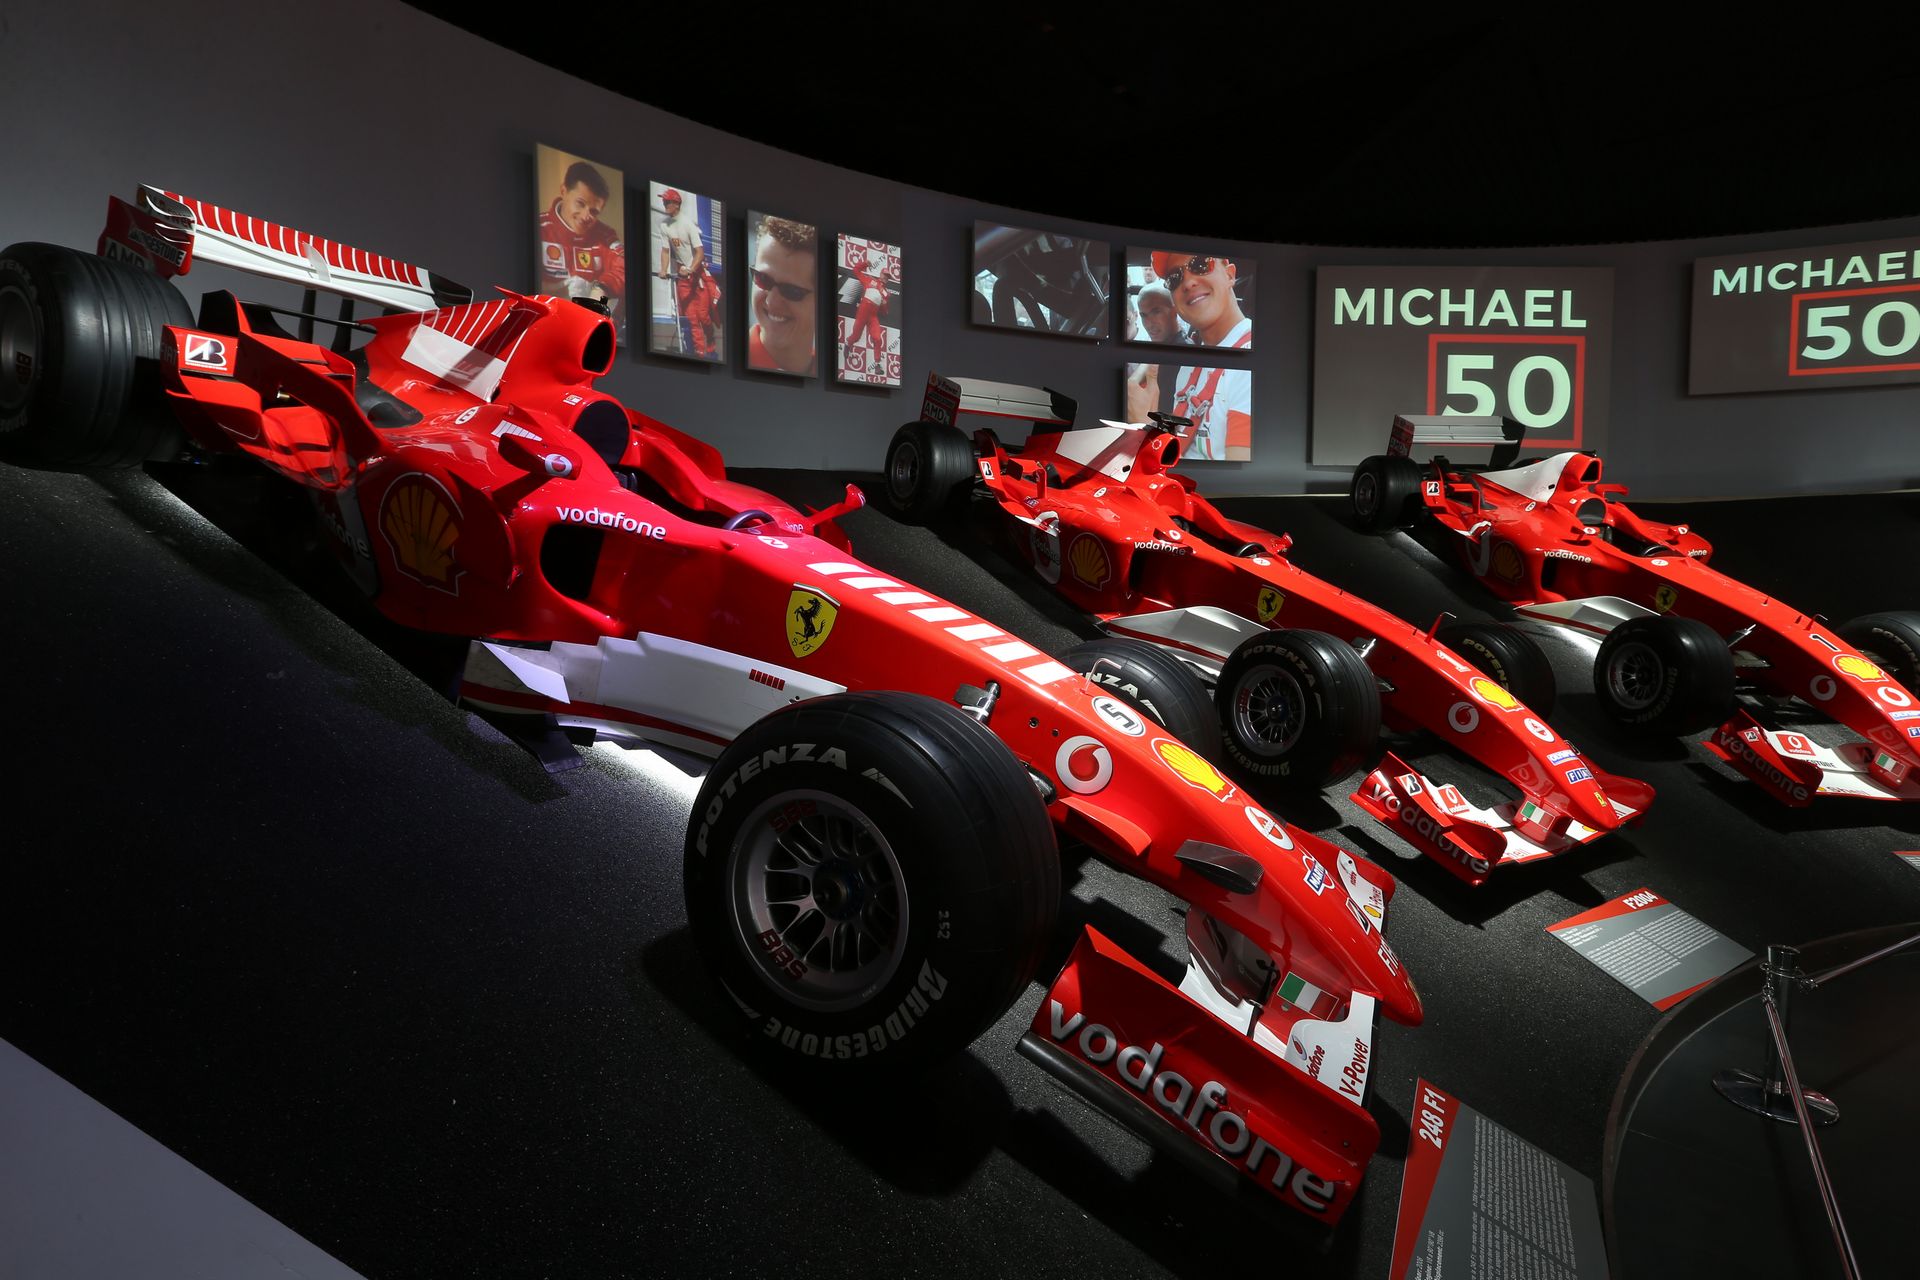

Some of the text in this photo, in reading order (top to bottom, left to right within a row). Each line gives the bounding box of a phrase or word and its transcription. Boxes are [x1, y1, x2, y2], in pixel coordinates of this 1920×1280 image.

[1334, 288, 1587, 328] MICHAEL
[1801, 301, 1920, 361] 50
[1441, 354, 1571, 429] 50
[556, 506, 667, 541] vodafone
[1134, 540, 1187, 556] vodafone
[1543, 549, 1592, 564] vodafone
[1078, 671, 1139, 699] NZA
[1242, 644, 1316, 688] POTENZA
[1462, 638, 1510, 692] POTENZ
[1101, 703, 1135, 728] 5
[1720, 732, 1809, 800] vodafone
[695, 743, 848, 858] POTENZA
[1373, 783, 1490, 874] vodafone
[1622, 890, 1659, 909] F2004
[757, 928, 809, 981] BBS
[764, 957, 949, 1060] BRIDGESTONE
[1338, 1036, 1369, 1098] V-Power
[1049, 998, 1336, 1211] vodafone
[1418, 1087, 1446, 1150] 248 F1
